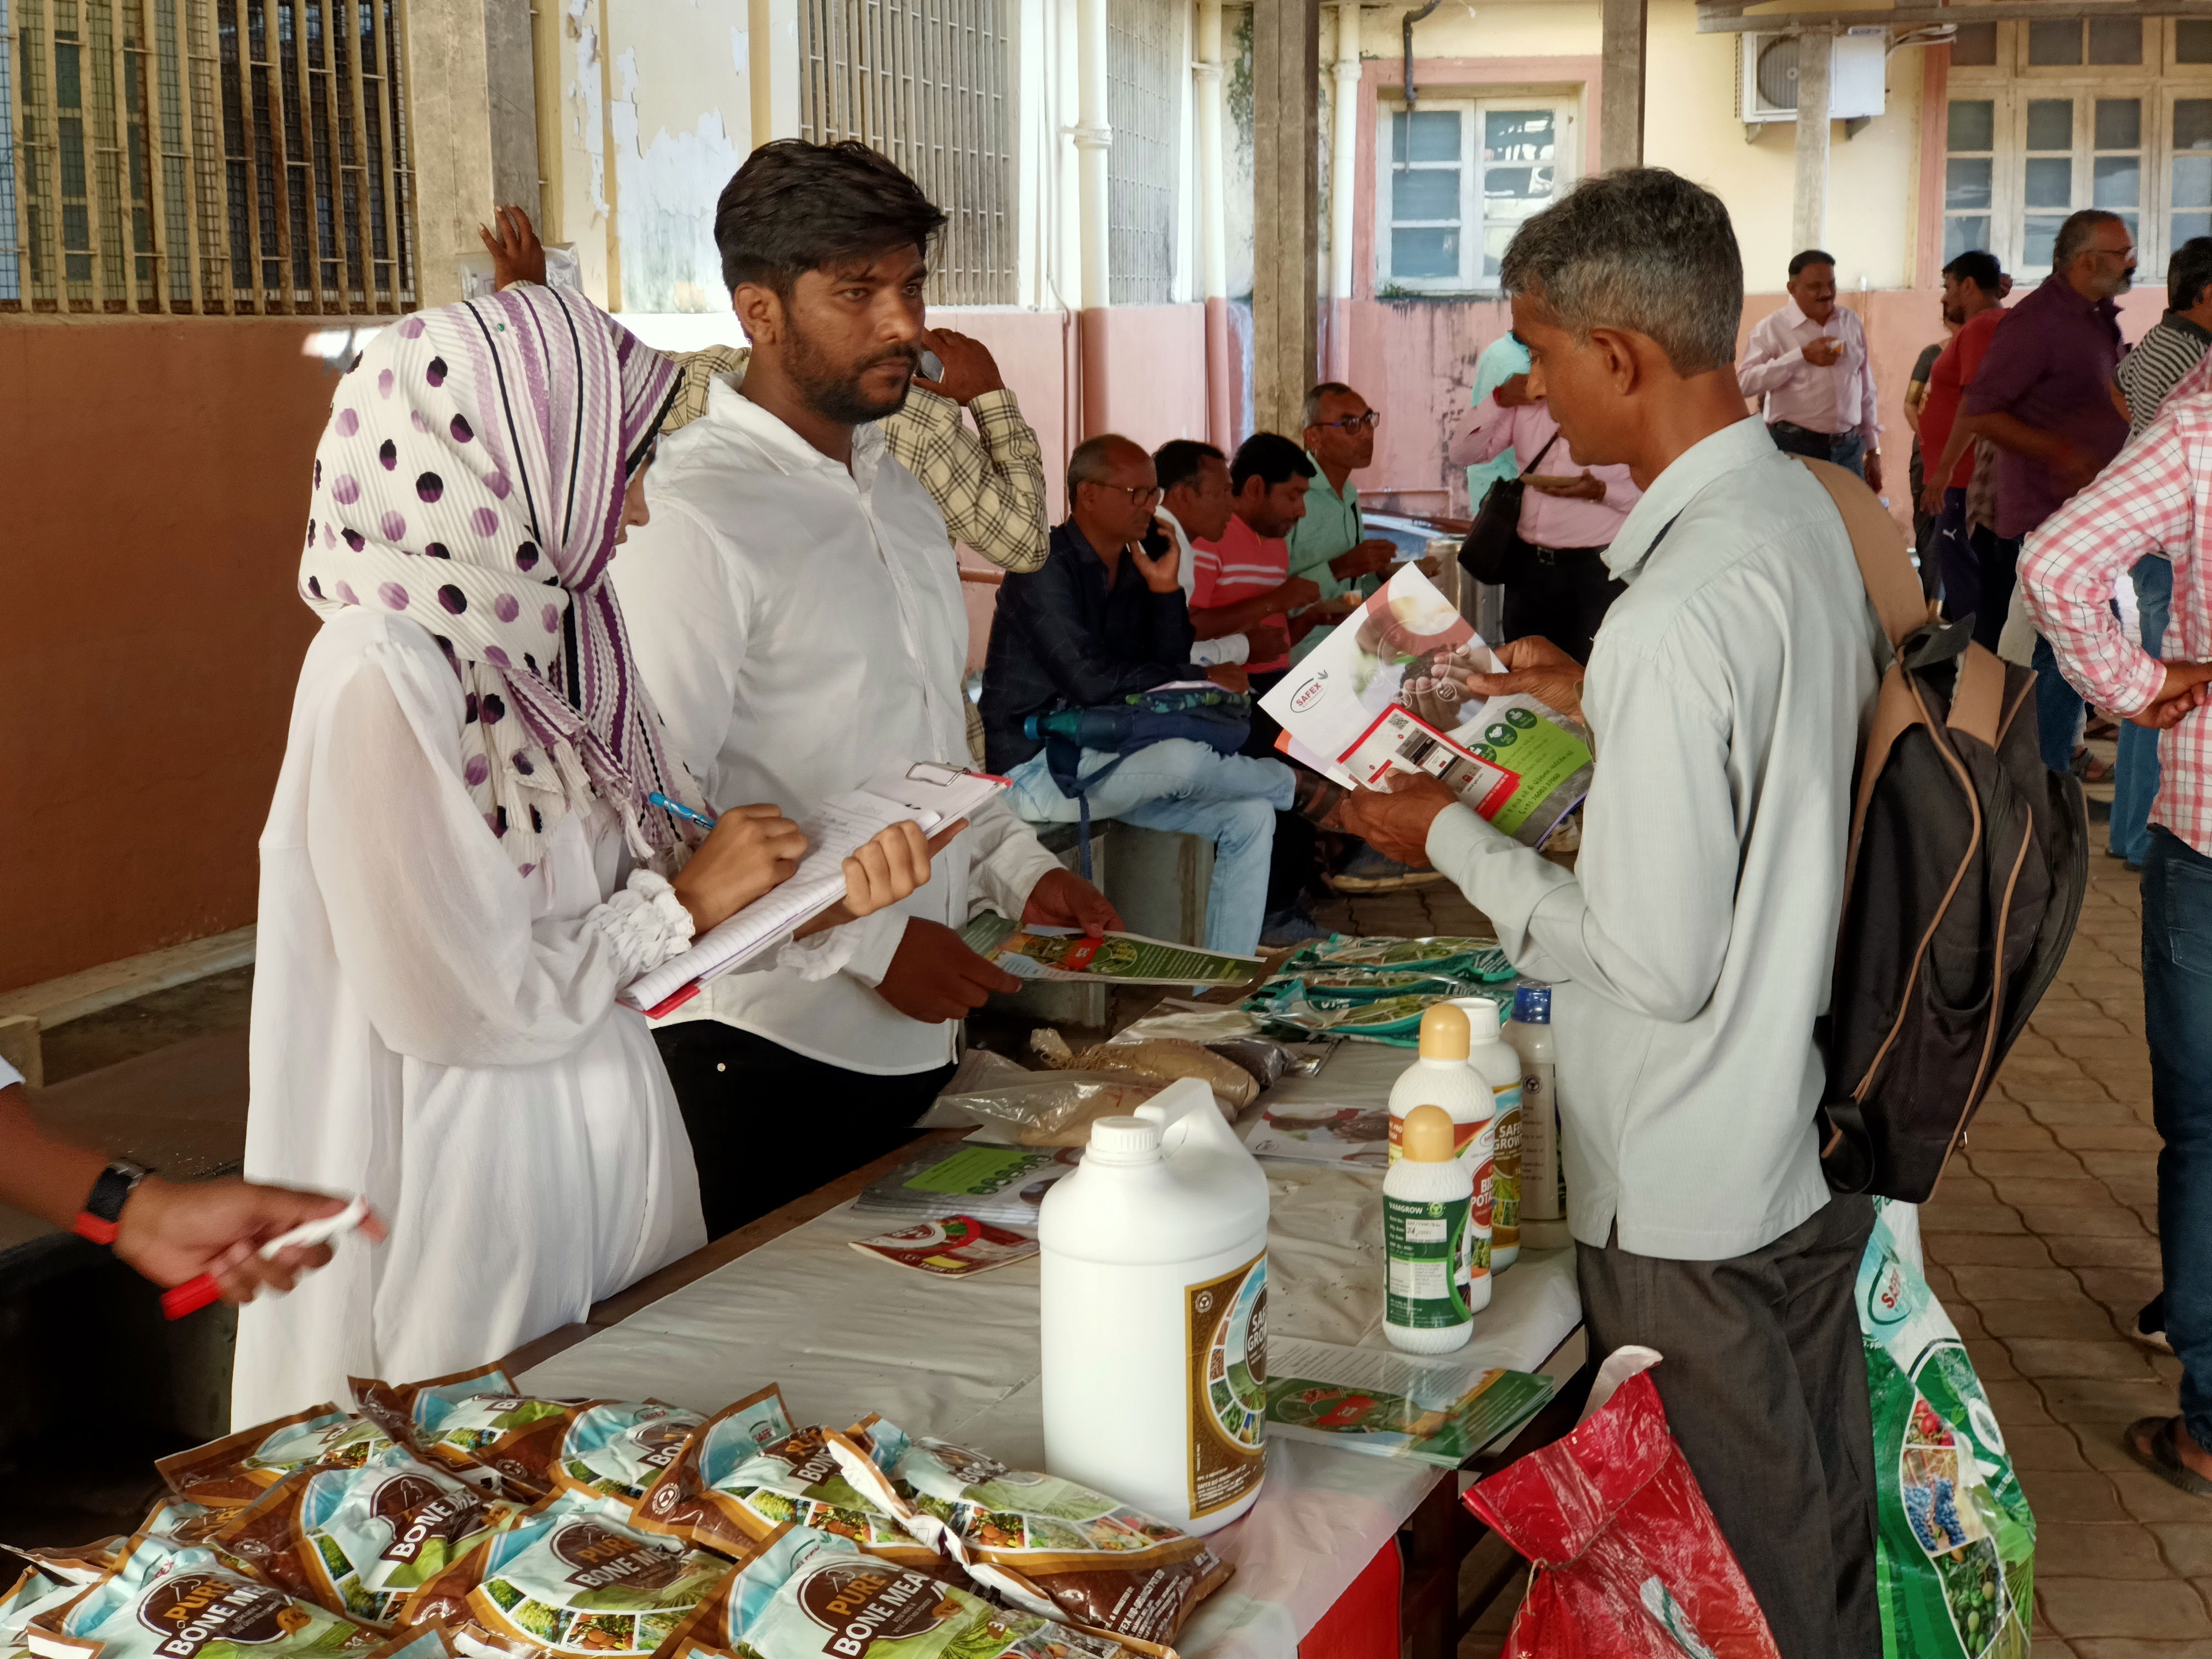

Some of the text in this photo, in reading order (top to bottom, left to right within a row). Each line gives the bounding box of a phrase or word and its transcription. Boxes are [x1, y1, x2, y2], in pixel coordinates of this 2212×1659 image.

[1296, 682, 1322, 706] SAFEX
[1494, 1133, 1522, 1151] GROWT
[1499, 1121, 1522, 1138] SAFE
[1389, 1202, 1423, 1214] VAMGROW
[1470, 1191, 1493, 1207] POTA
[1252, 1303, 1267, 1332] SAF
[797, 1448, 837, 1481] BON
[389, 1502, 453, 1558] BONE
[575, 1557, 641, 1587] BONE
[164, 1579, 233, 1620] PURE
[826, 1572, 888, 1615] PURE
[833, 1573, 932, 1656] BONE MEA
[1118, 1618, 1132, 1635] FEX
[164, 1604, 238, 1656] BONE
